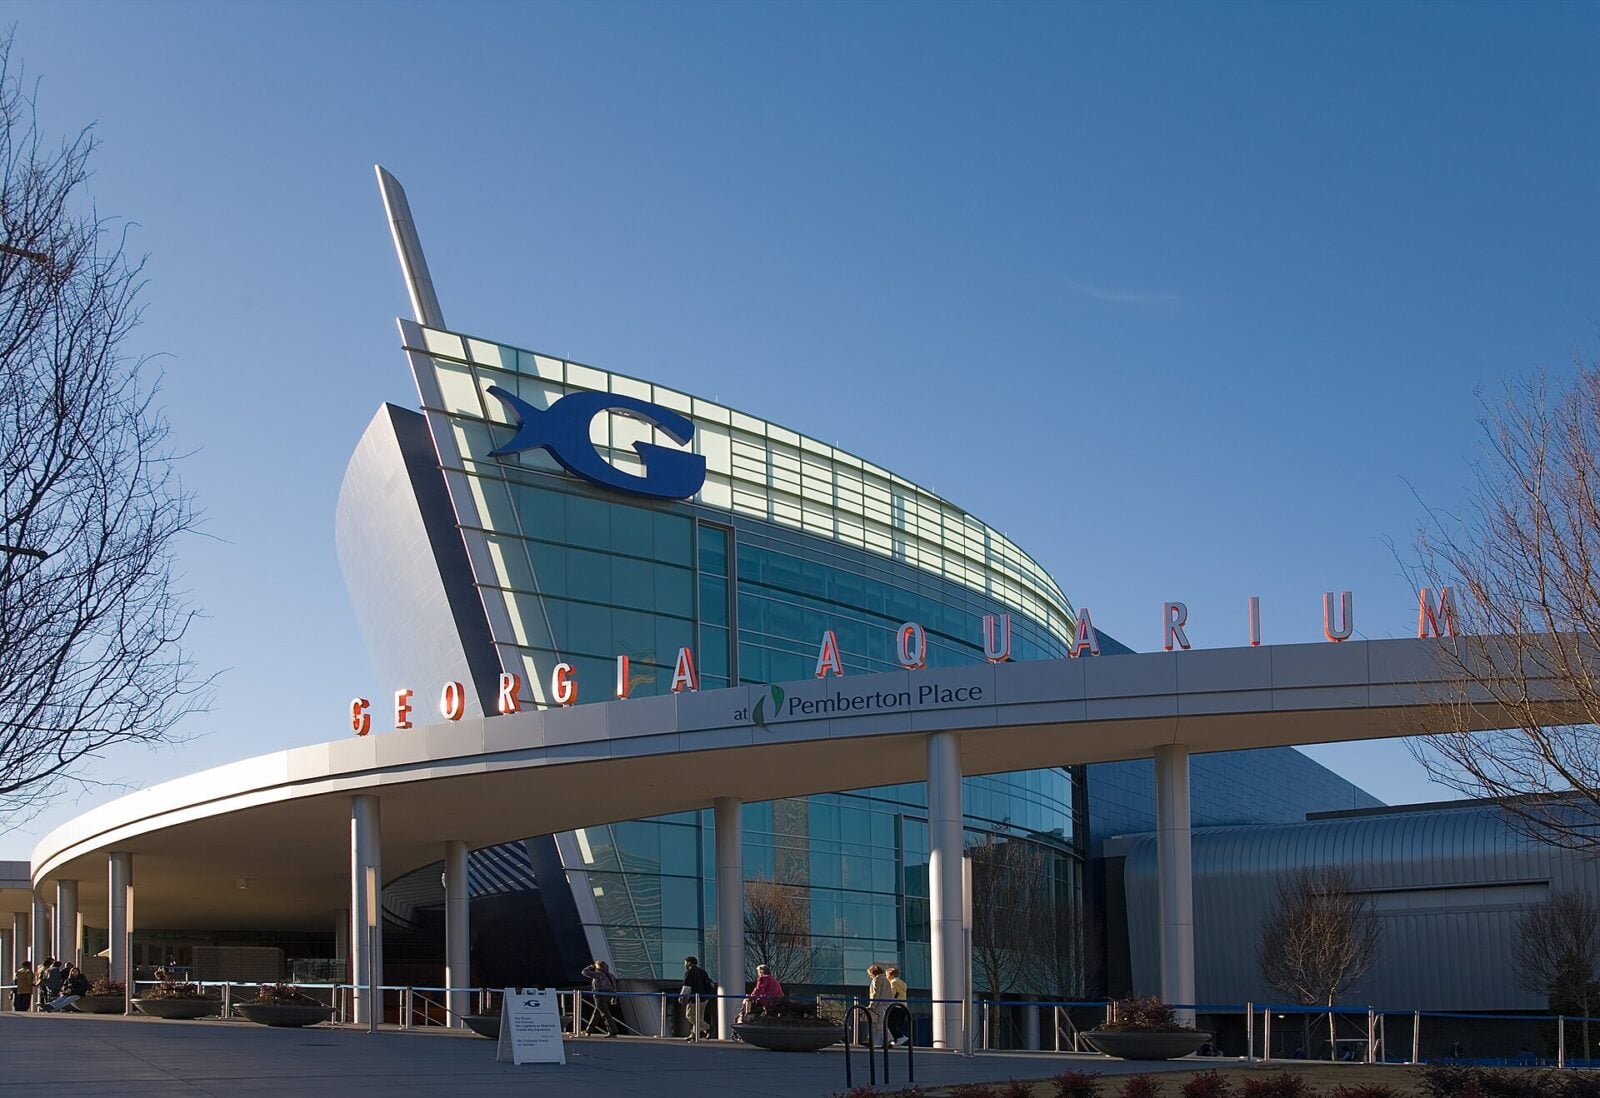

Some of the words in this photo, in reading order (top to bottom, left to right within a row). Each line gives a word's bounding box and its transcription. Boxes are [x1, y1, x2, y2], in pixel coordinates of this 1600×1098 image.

[348, 646, 700, 736] GEORGIA
[814, 586, 1460, 679] AQUARIUM
[733, 708, 749, 721] at
[788, 691, 911, 715] Pemberton
[918, 684, 983, 705] Place
